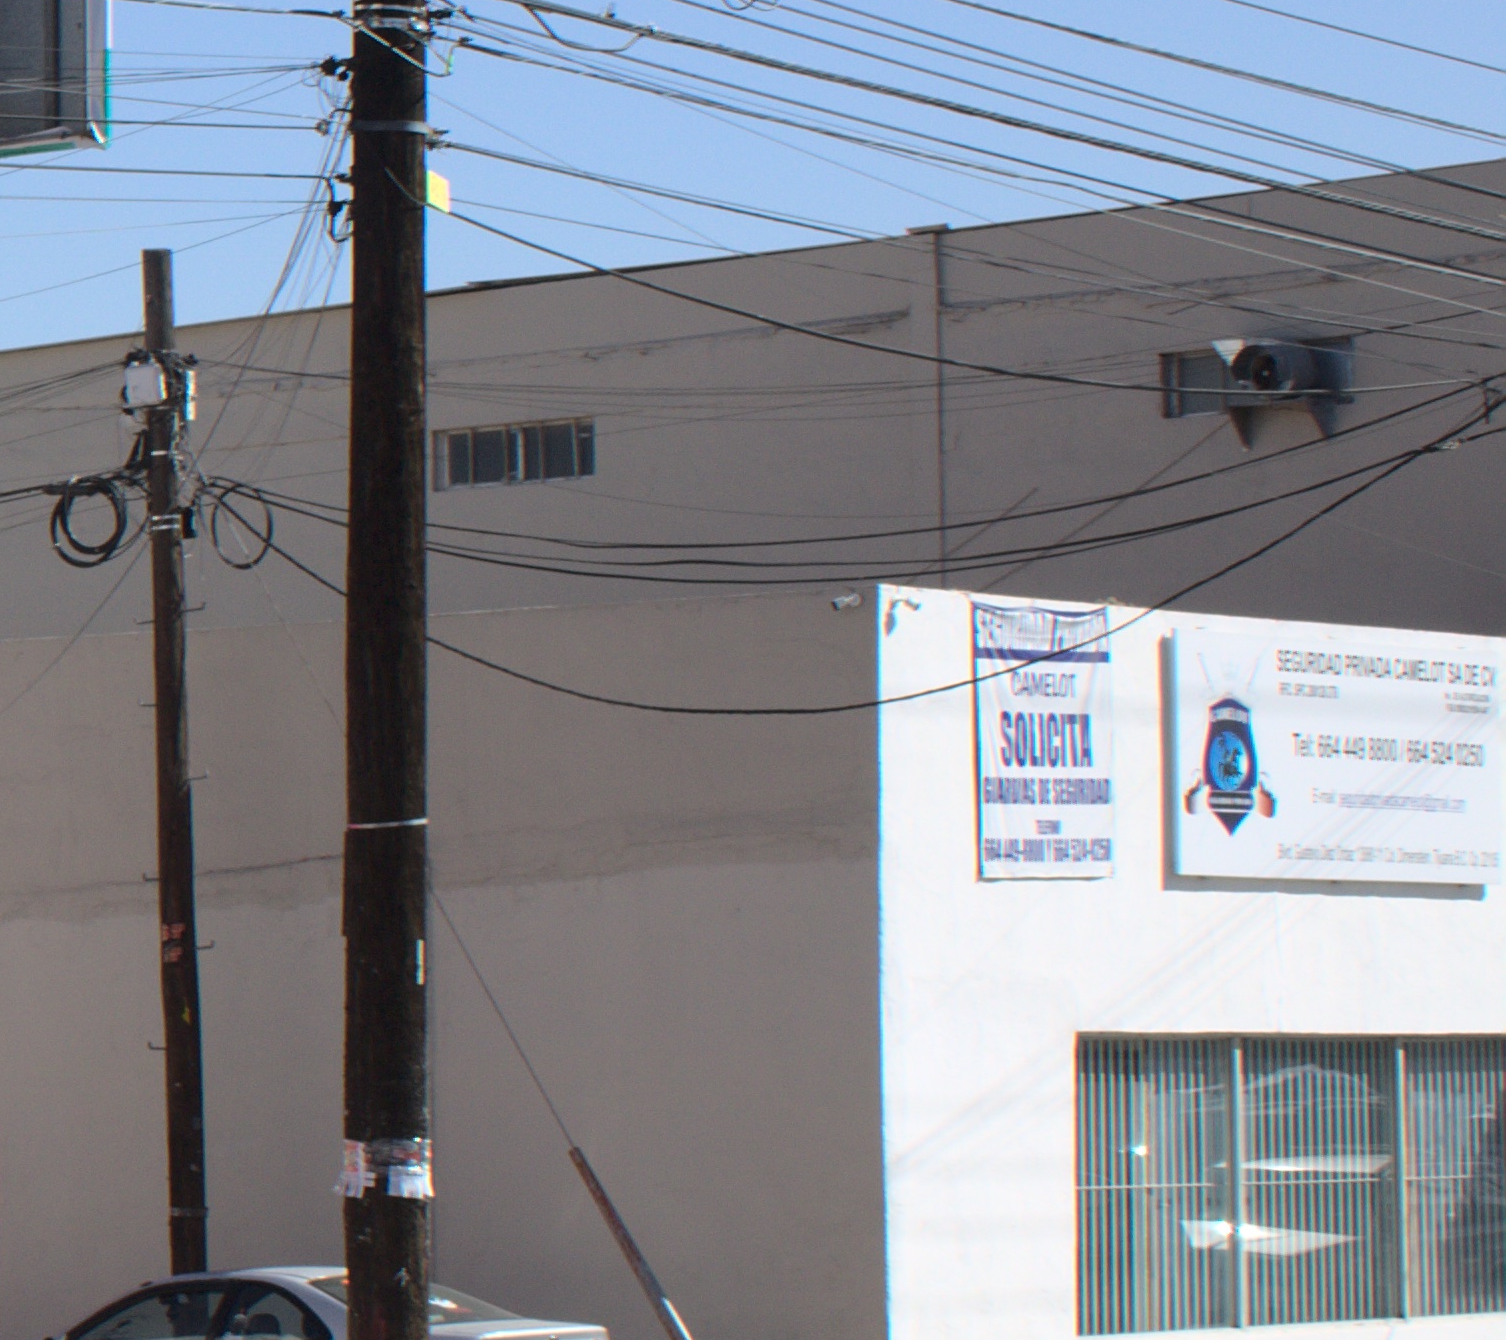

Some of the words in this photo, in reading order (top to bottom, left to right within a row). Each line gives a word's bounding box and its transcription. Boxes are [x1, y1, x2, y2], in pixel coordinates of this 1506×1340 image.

[1276, 648, 1342, 676] SEGURIDAD
[1011, 670, 1076, 698] CAMELOT
[1000, 710, 1093, 768] SOLICITA
